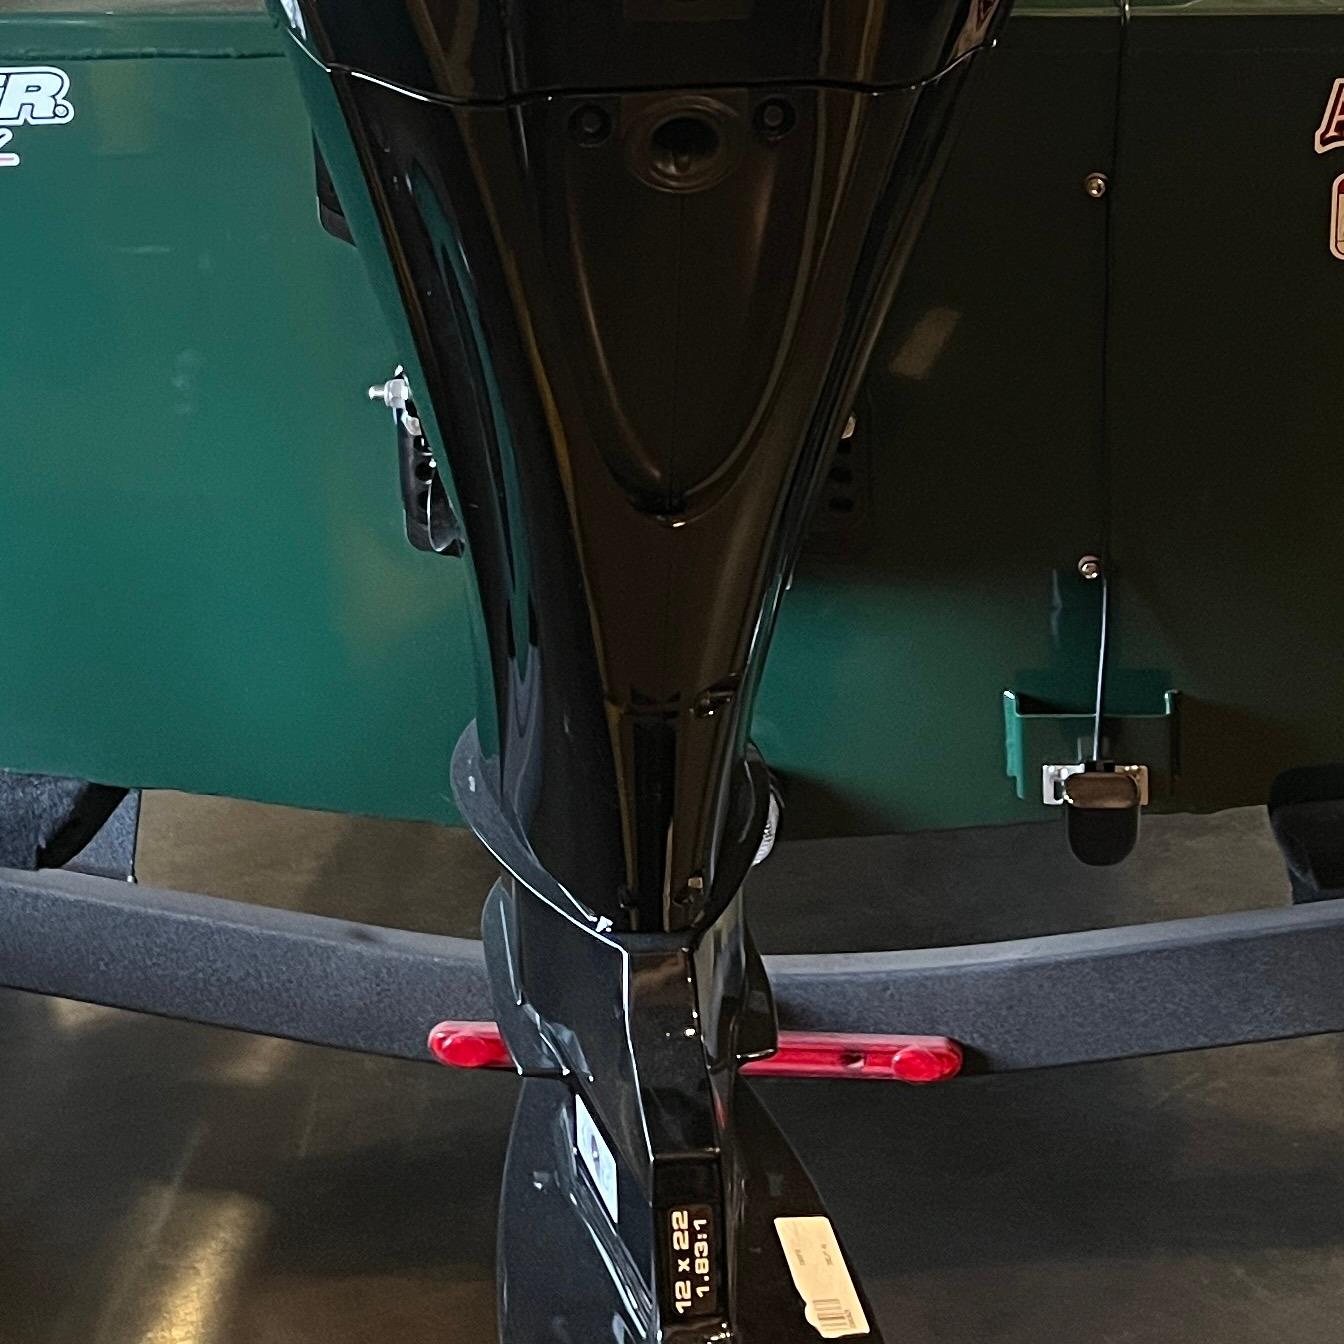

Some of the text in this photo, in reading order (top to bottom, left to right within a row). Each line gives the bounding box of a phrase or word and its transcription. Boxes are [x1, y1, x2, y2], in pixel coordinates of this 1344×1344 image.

[671, 1210, 689, 1250] 22
[693, 1219, 710, 1298] 1.83:1
[675, 1280, 692, 1314] 12
